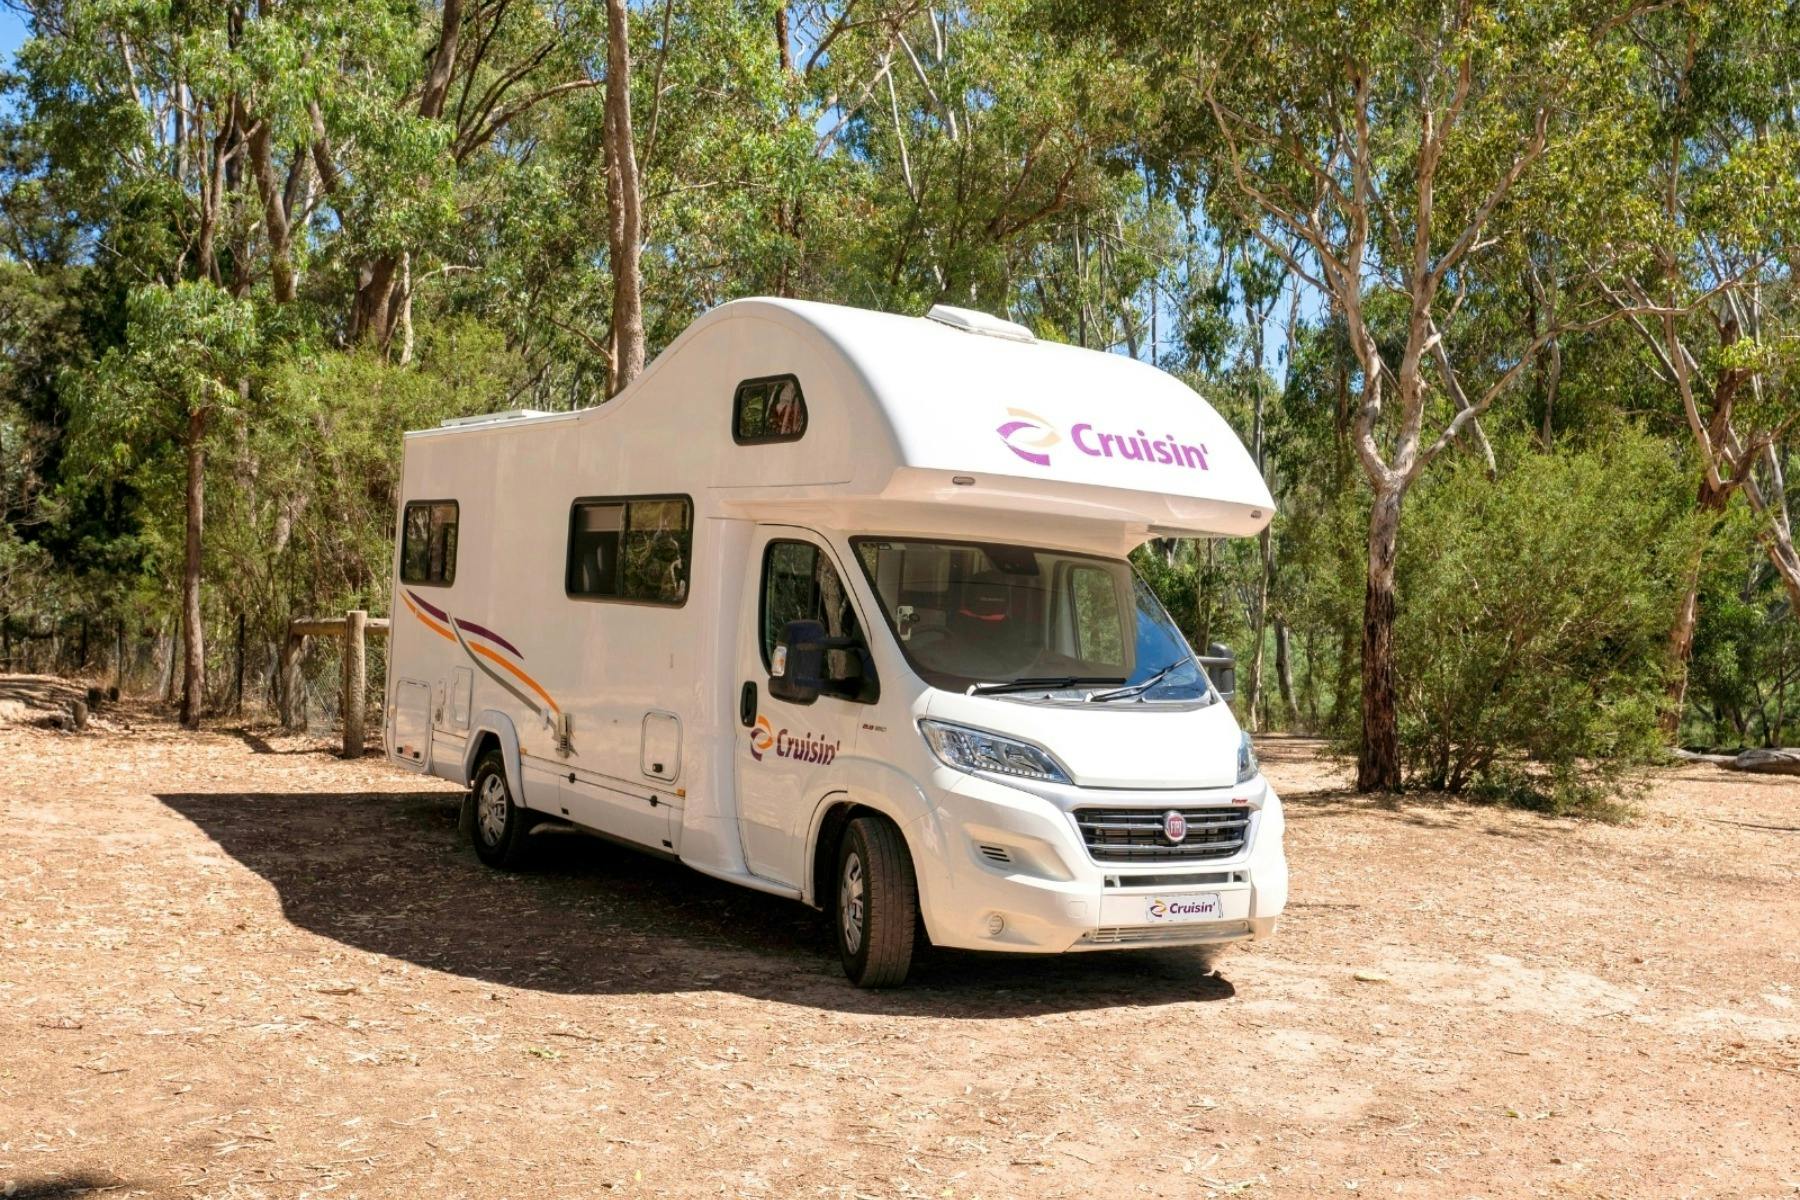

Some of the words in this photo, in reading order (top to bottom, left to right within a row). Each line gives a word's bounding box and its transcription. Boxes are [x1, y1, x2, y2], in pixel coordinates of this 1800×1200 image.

[1071, 423, 1208, 470] Cruisin'
[776, 728, 840, 765] Cruisin'
[1169, 902, 1216, 914] Cruisin'
